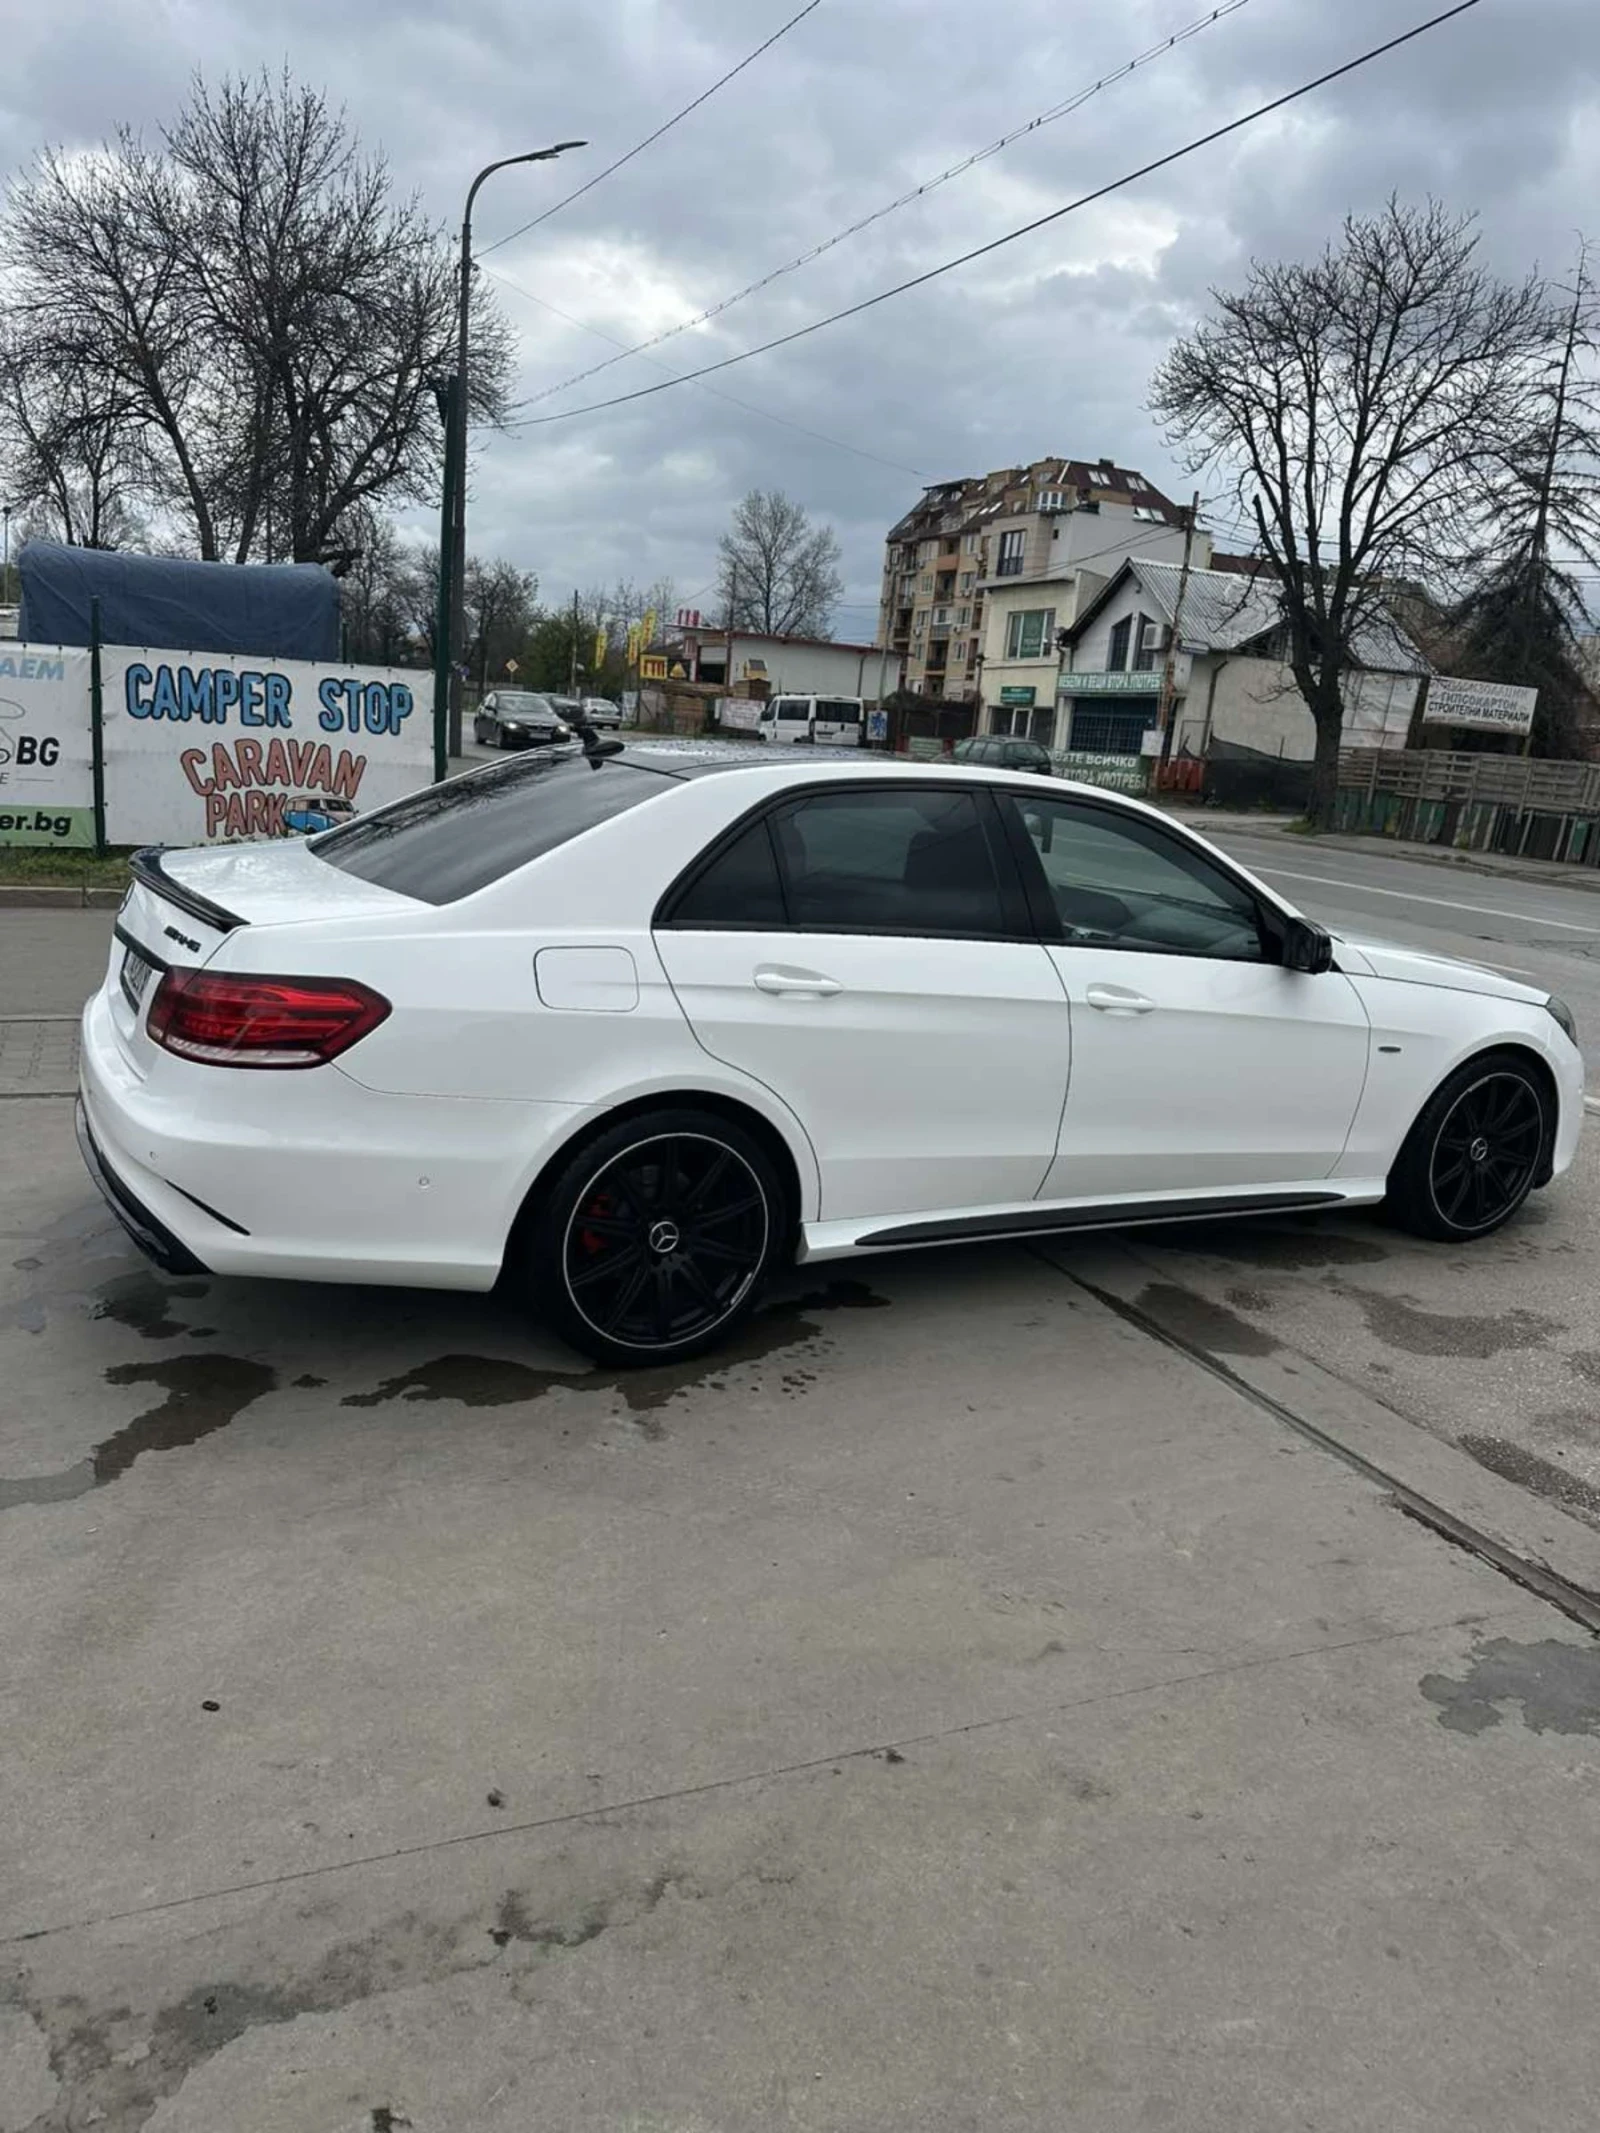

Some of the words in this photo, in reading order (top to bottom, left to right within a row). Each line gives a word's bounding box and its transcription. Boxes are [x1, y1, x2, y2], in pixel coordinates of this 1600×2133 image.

[125, 663, 292, 728] CAMPER
[318, 677, 414, 736] STOP
[1428, 702, 1481, 717] СТРОИТЕЛНИ
[1482, 707, 1530, 723] МАТЕРИАЛИ
[16, 735, 60, 768] BG
[180, 738, 367, 800] CARAVAN
[206, 790, 288, 838] PARK
